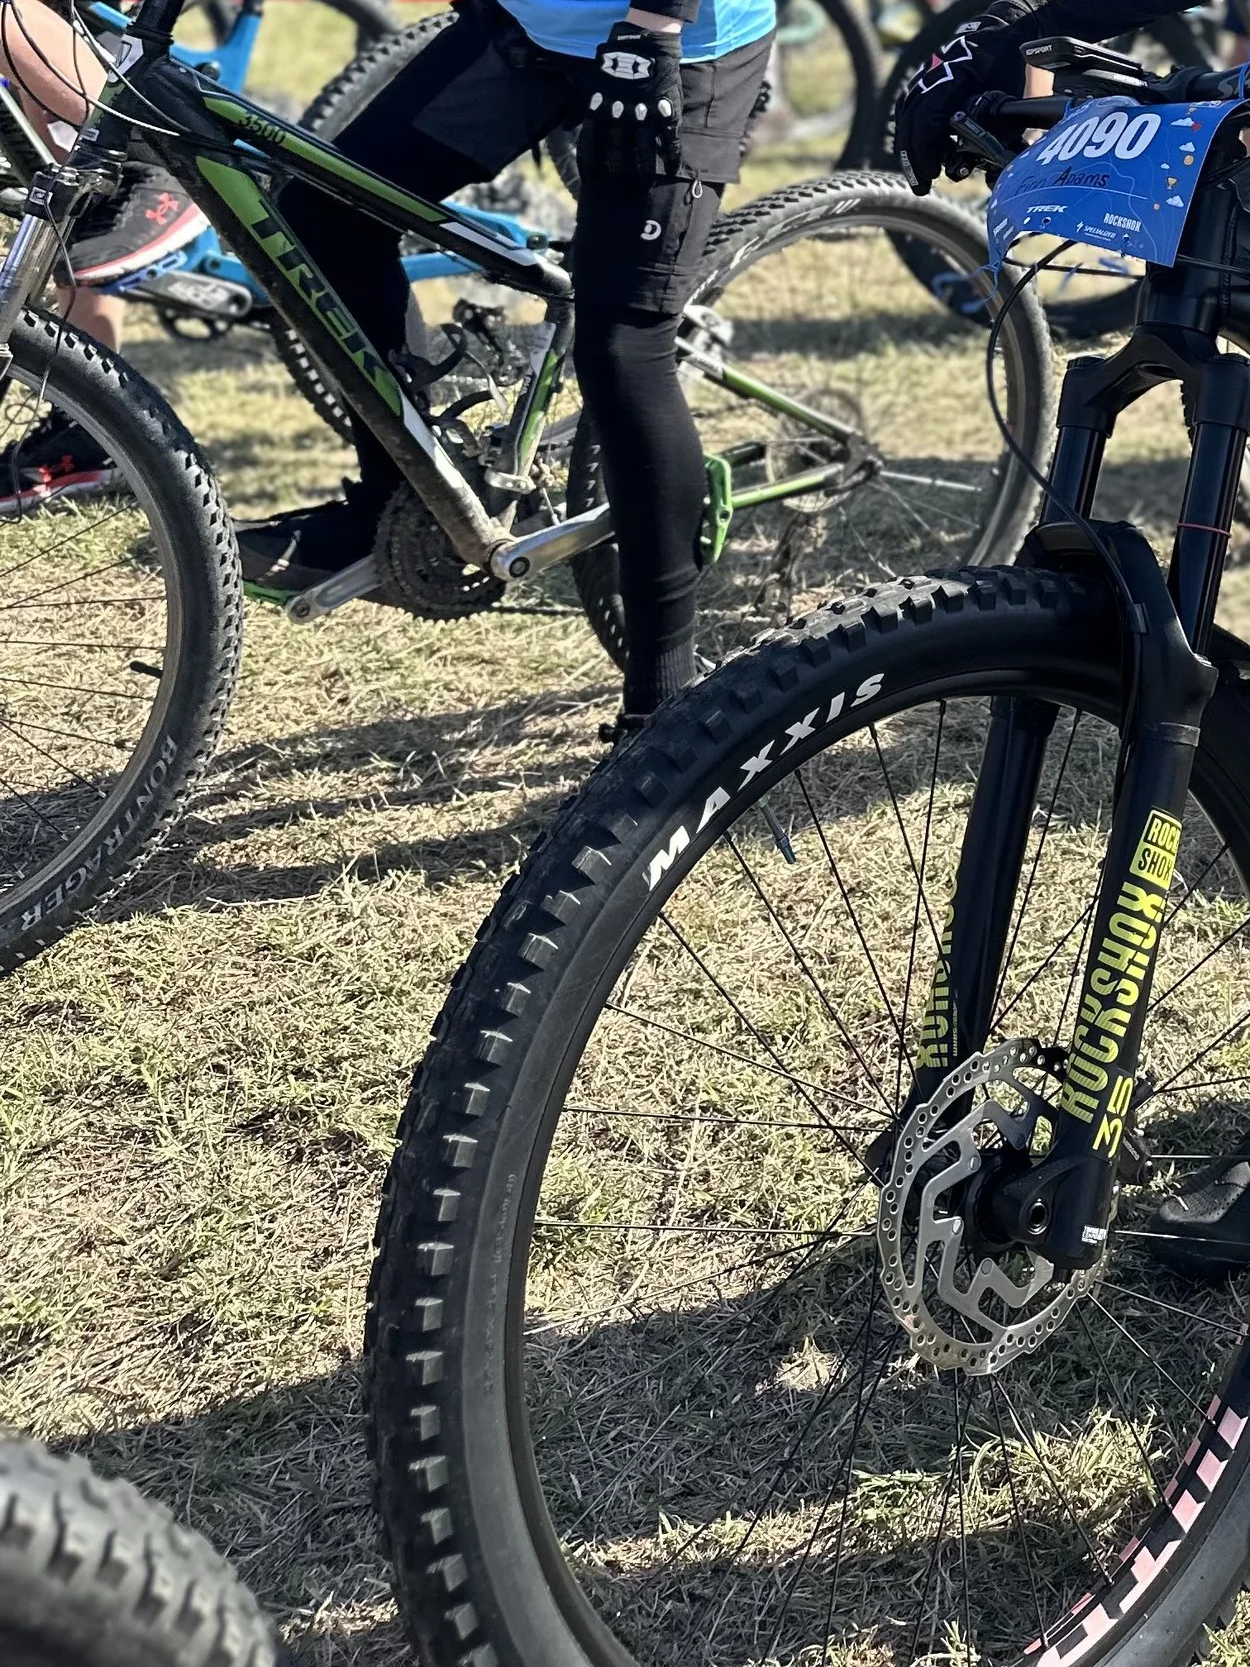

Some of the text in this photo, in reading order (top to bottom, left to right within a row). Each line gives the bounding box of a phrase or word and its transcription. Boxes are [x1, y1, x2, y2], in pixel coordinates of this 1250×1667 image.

[239, 112, 287, 147] 3500
[1036, 111, 1162, 166] 4090
[1026, 205, 1068, 213] TREK
[1104, 212, 1142, 233] ROCKSHOX
[250, 199, 388, 382] TREK
[649, 673, 885, 893] MAXXIS
[1138, 847, 1174, 882] SHOX
[1060, 881, 1167, 1124] ROCKSHOX
[1092, 1074, 1134, 1159] 35
